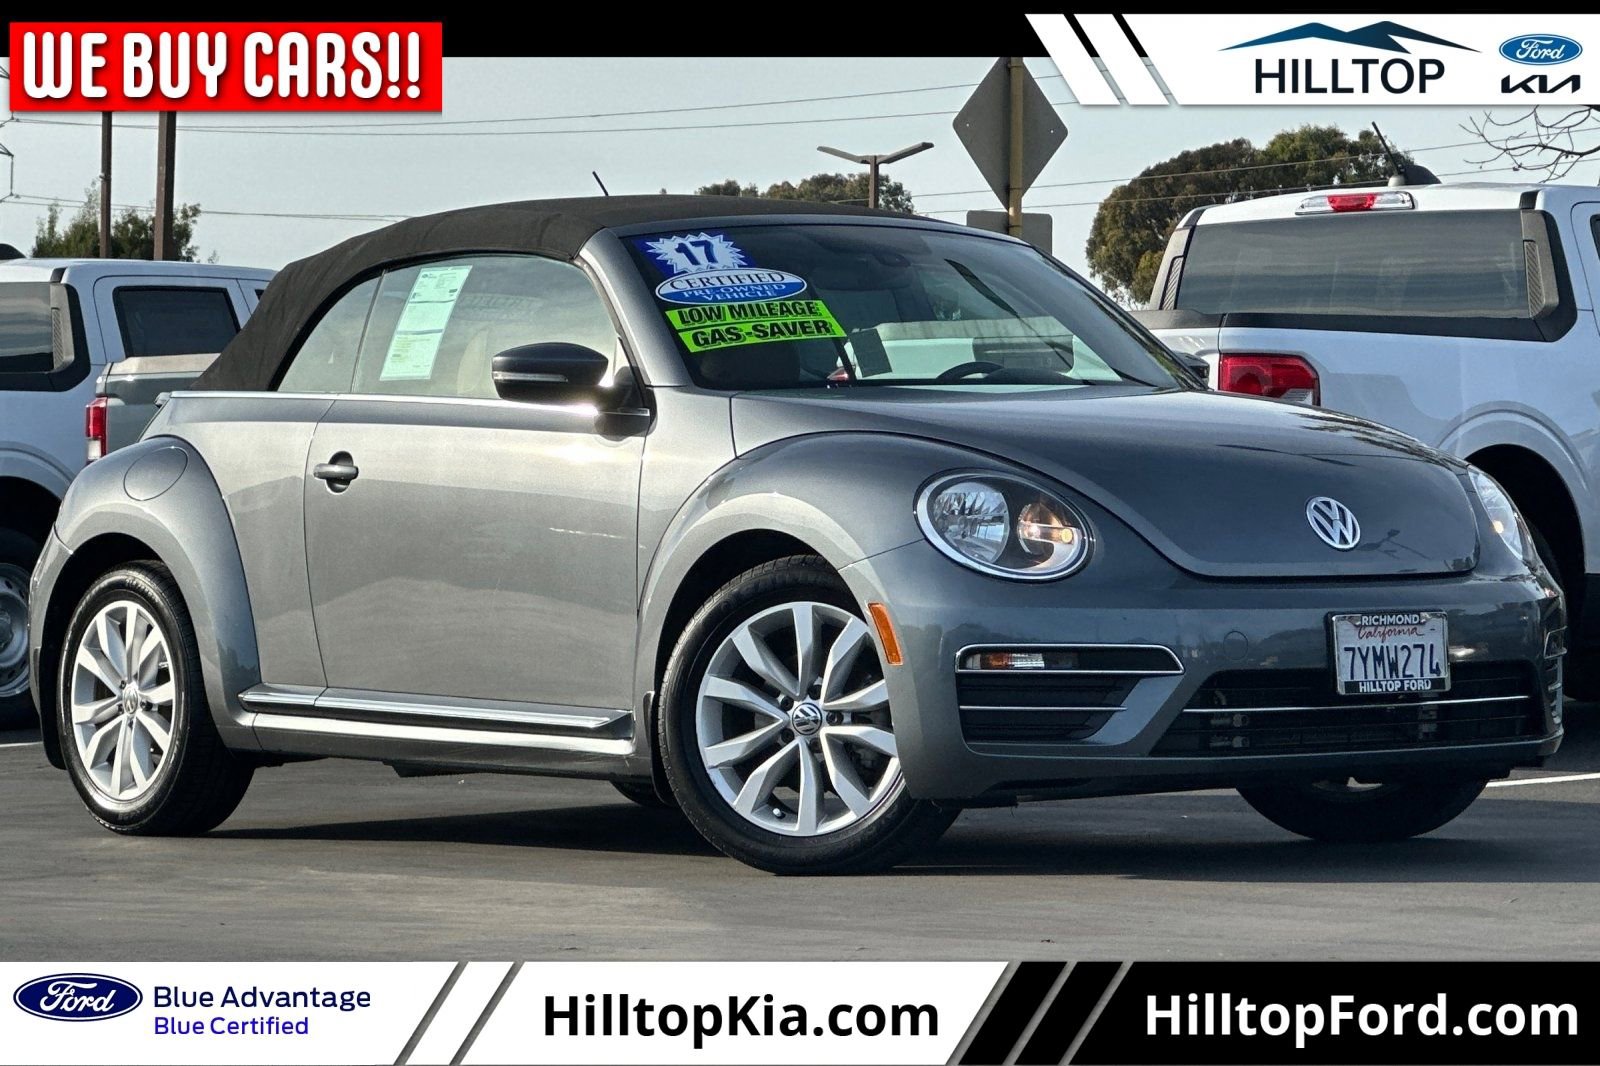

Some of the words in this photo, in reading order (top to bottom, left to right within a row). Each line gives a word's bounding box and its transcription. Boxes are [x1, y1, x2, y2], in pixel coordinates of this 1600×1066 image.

[675, 239, 718, 266] 17
[670, 271, 786, 291] CERTIFIED
[682, 284, 787, 298] PRE-OWNED
[702, 289, 778, 301] VEHICLE
[677, 305, 726, 325] LOW
[729, 301, 822, 321] MILEAGE
[691, 319, 834, 348] GAS-SAVER
[1361, 614, 1420, 626] RICHMOND
[1358, 625, 1425, 643] California
[1343, 643, 1442, 680] 7YMW274
[1359, 680, 1402, 692] HILLTOP
[1404, 679, 1432, 691] FORD
